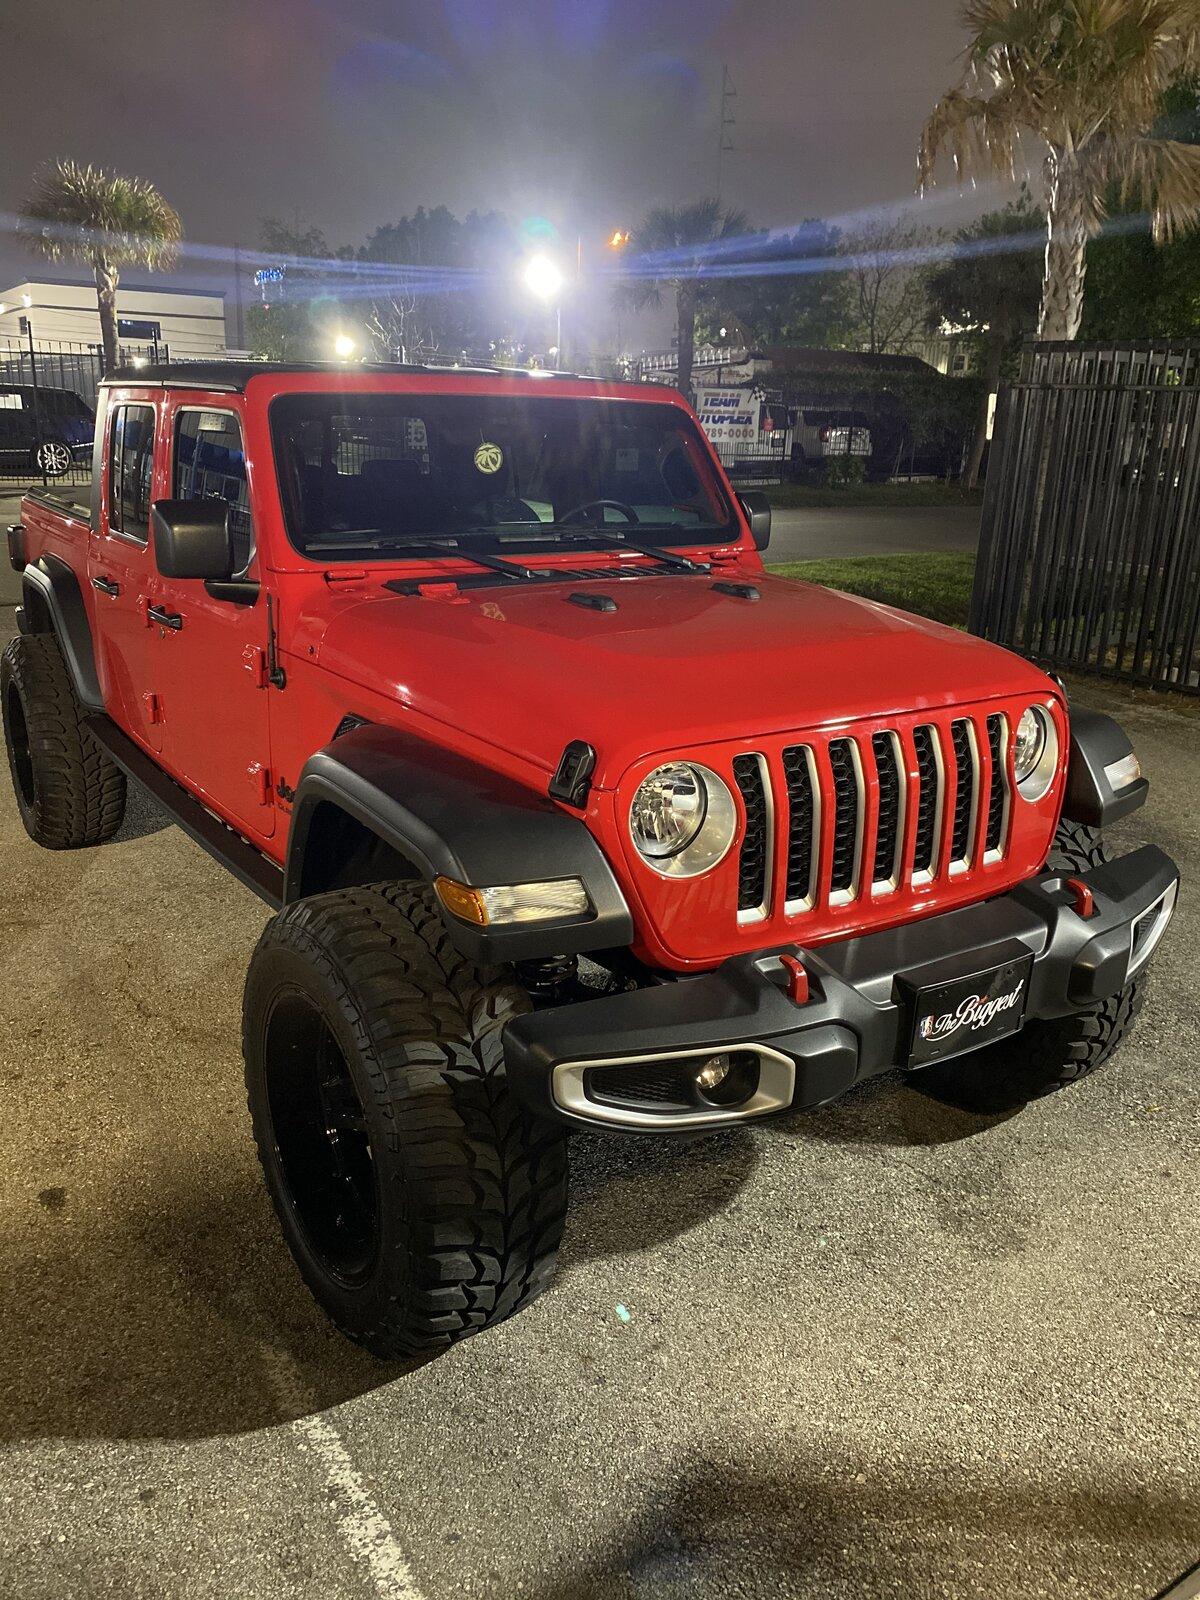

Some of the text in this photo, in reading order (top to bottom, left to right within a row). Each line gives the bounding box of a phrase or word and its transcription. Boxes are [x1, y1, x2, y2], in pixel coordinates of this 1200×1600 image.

[704, 391, 742, 407] TEAM
[697, 409, 756, 425] UTOPLEX
[932, 1013, 958, 1035] The
[956, 979, 1024, 1030] Biggest
